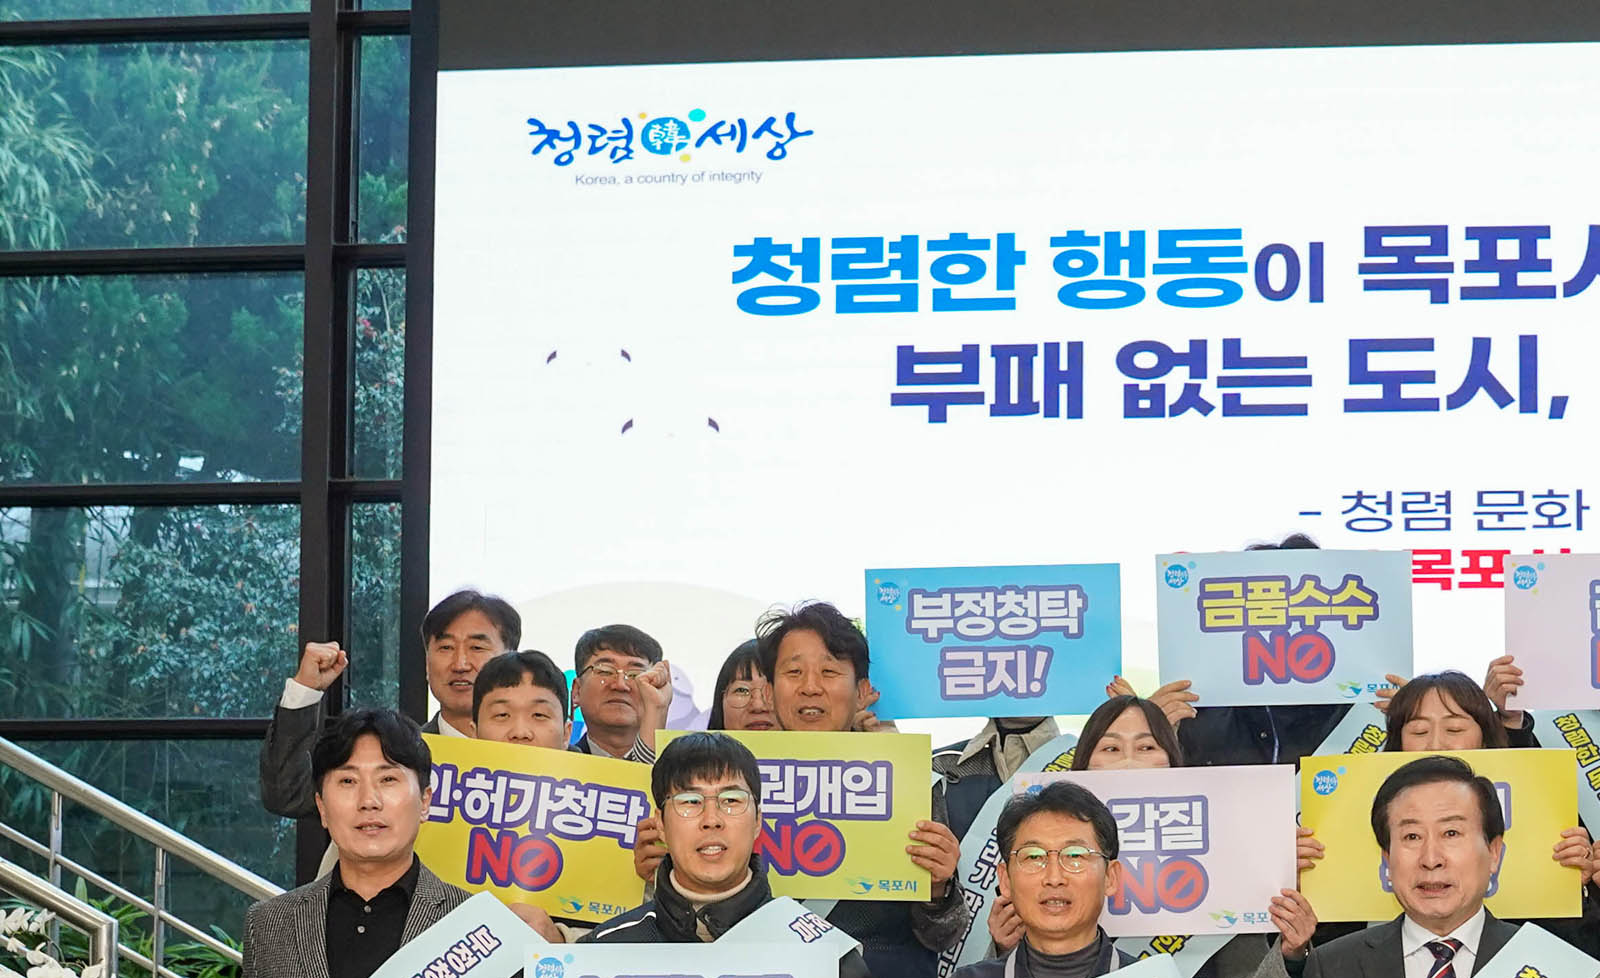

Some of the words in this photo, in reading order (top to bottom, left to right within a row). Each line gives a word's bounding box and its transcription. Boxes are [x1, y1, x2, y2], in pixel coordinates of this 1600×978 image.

[575, 173, 620, 186] Korea,
[637, 172, 687, 187] country
[691, 170, 705, 183] of
[709, 169, 763, 185] integrity
[732, 231, 1026, 316] 청렴한
[1050, 228, 1324, 310] 행동이
[890, 341, 1084, 424] 부패
[1115, 337, 1313, 418] 없는
[1343, 334, 1570, 420] 도시,
[1341, 490, 1453, 533] 청렴
[1472, 488, 1590, 533] 문화
[1411, 547, 1572, 591] 목포
[910, 588, 1084, 640] 부정청탁
[1202, 579, 1374, 628] 금품수수
[943, 649, 1049, 696] 금지!
[1247, 633, 1332, 680] NO
[760, 764, 887, 816] 권개입
[1112, 801, 1203, 851] 갑질
[470, 833, 560, 886] NO
[588, 901, 627, 915] 목포시
[879, 880, 917, 893] 목포시
[1113, 860, 1204, 910] NO
[1242, 911, 1269, 925] 목포
